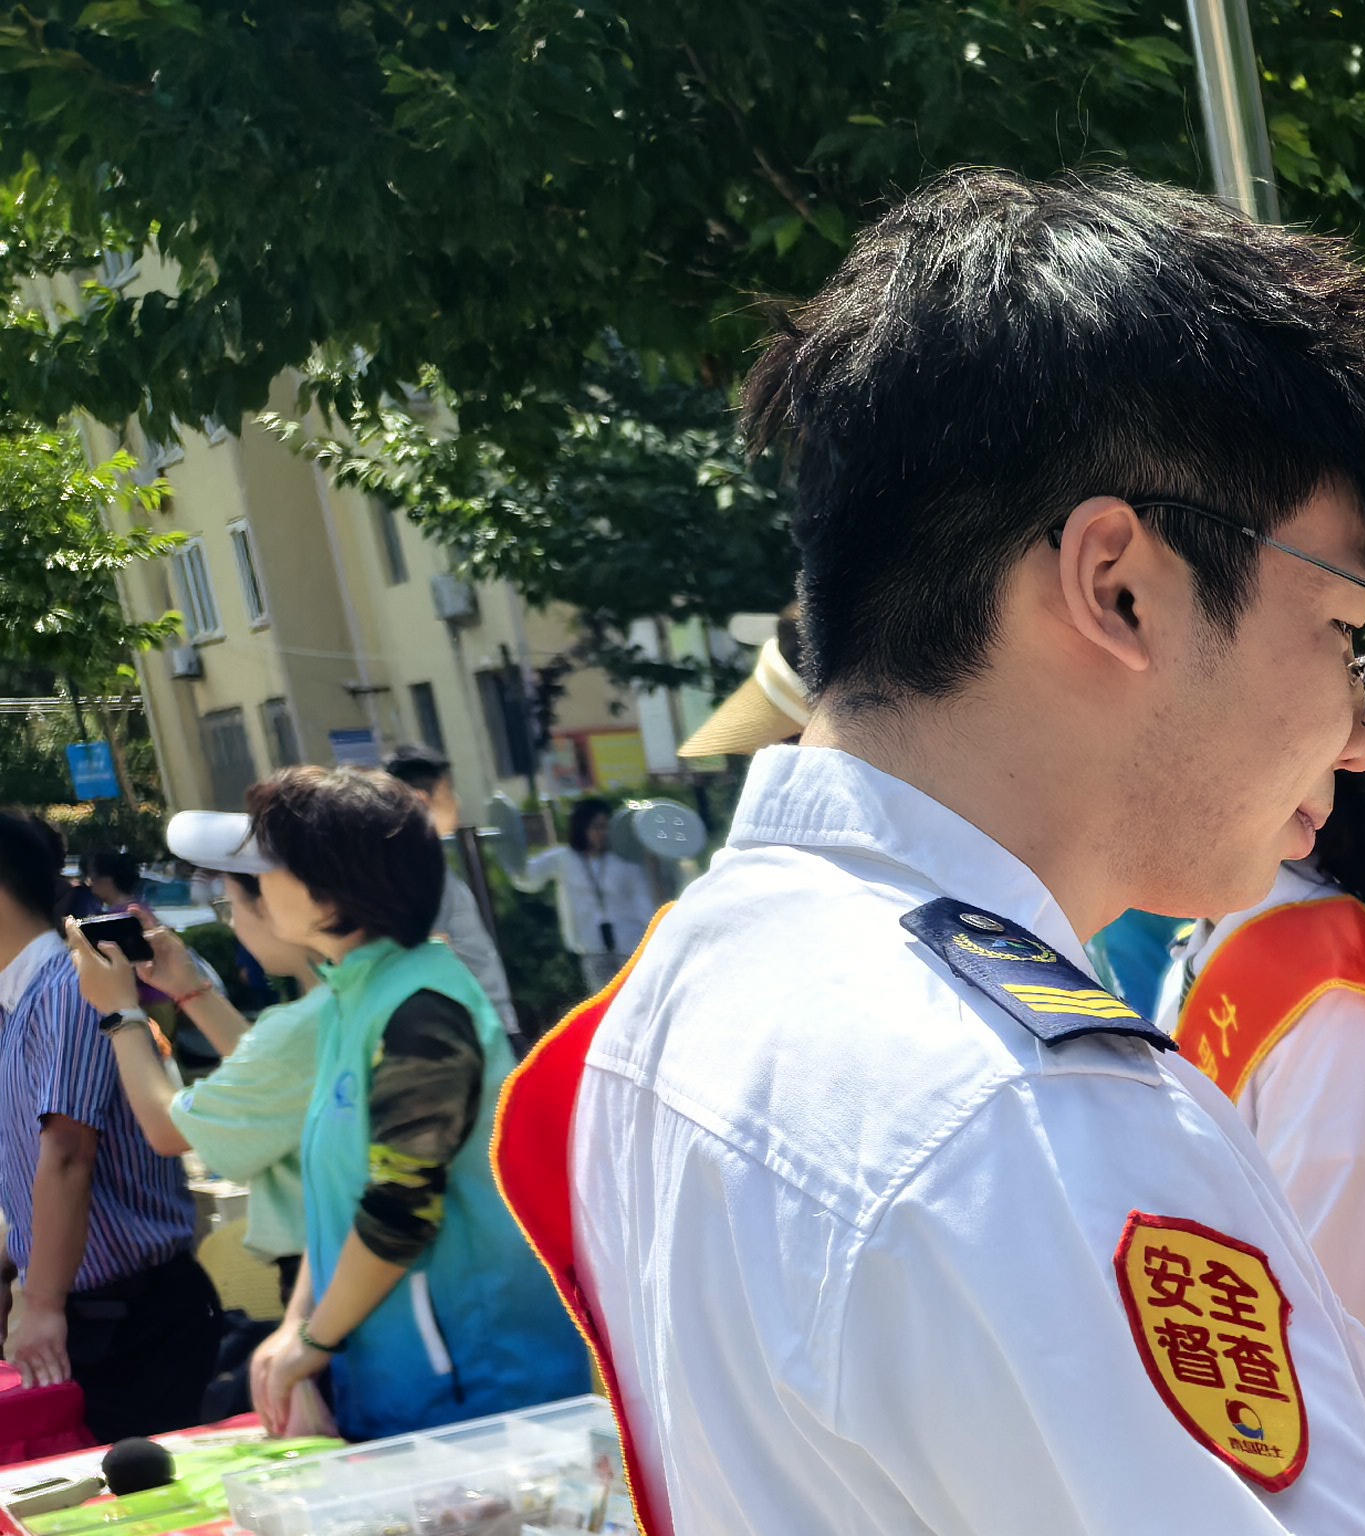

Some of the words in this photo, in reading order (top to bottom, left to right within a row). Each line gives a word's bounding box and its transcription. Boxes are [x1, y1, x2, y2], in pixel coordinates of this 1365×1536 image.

[1143, 1245, 1267, 1333] 安全
[1153, 1317, 1292, 1403] 督查
[1227, 1436, 1285, 1459] 青岛巴士
